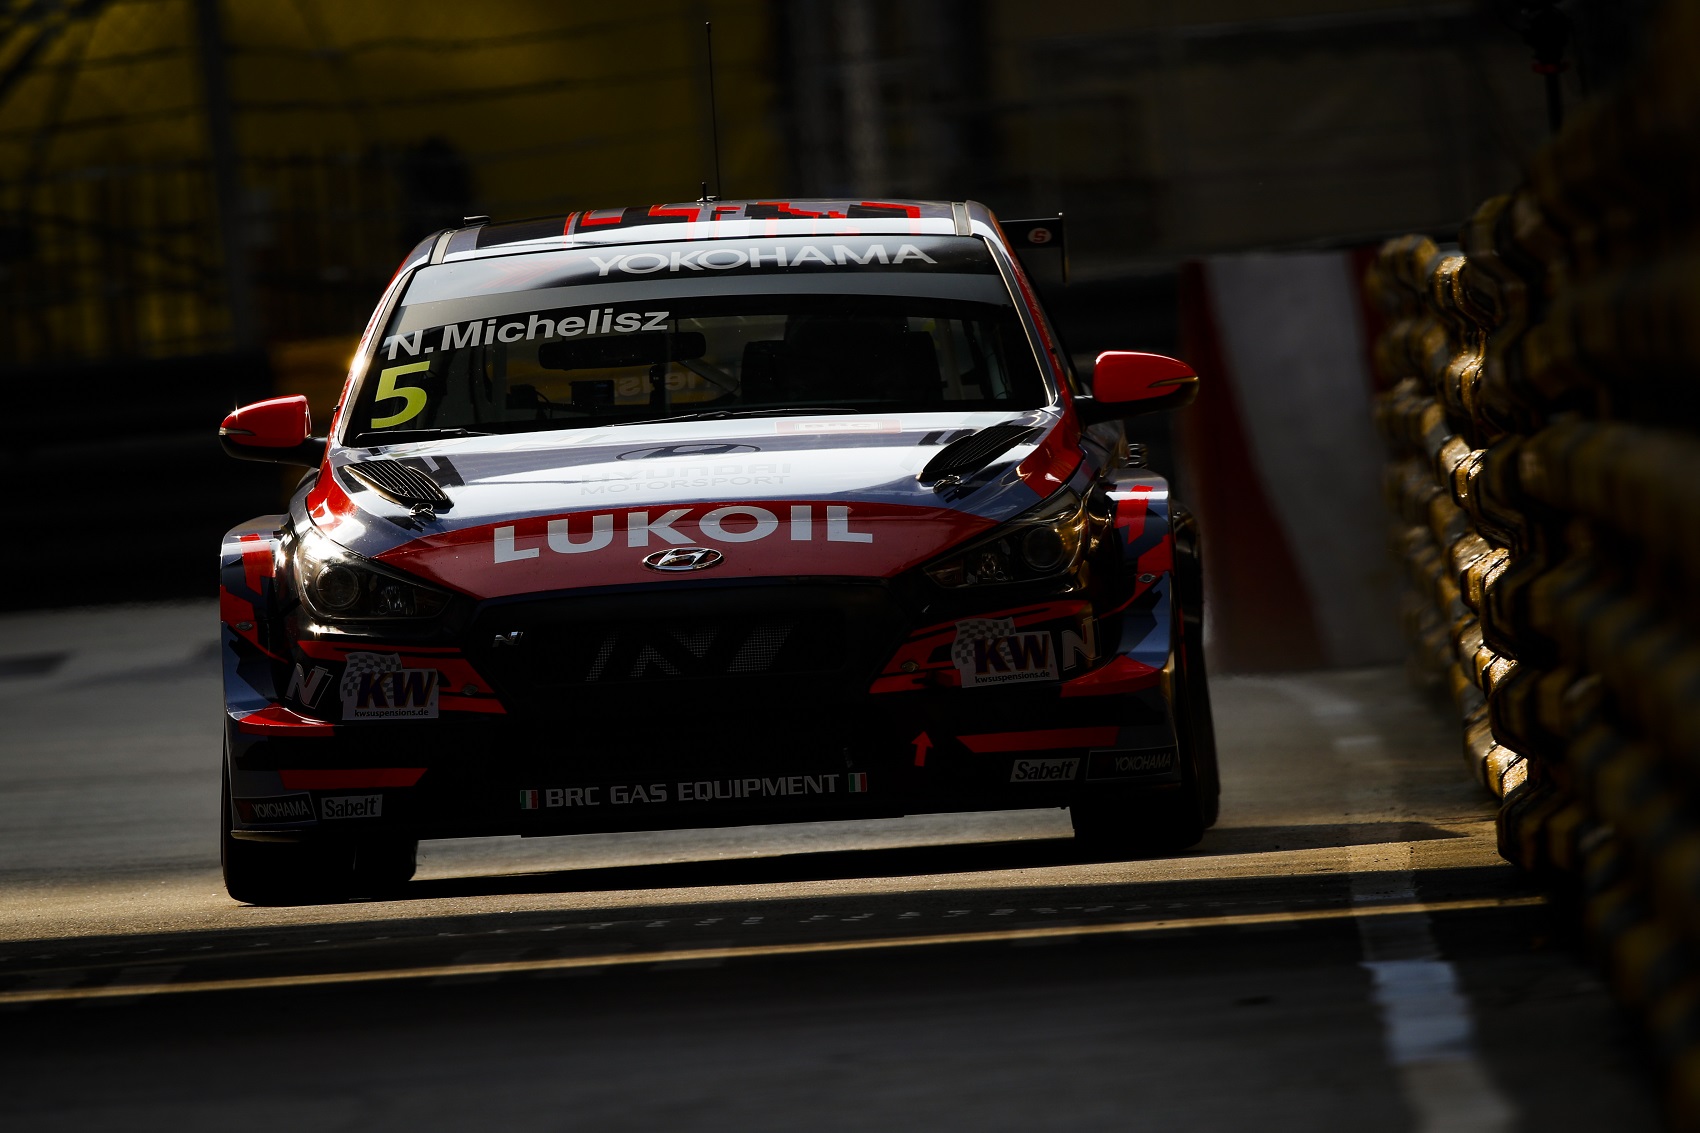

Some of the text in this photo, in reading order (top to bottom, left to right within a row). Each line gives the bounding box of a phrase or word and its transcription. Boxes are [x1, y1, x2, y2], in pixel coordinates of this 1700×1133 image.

[588, 243, 938, 277] YOKOHAMA
[386, 307, 670, 361] N. Michelisz
[370, 360, 431, 429] 5
[580, 475, 790, 496] MOTORSPORT
[581, 463, 792, 484] HYUNDAI
[493, 505, 873, 563] LUKOIL
[974, 634, 1050, 674] KW
[284, 663, 333, 710] N
[356, 671, 436, 708] KW
[974, 670, 1050, 684] kwsuspensions.de
[354, 709, 429, 718] kwsuspensions.de
[1015, 760, 1075, 781] Sabelt
[1115, 752, 1171, 773] YOKOHAMA
[545, 773, 840, 808] BRC GAS EQUIPMENT
[251, 800, 311, 819] YOKOHAMA
[324, 797, 378, 818] Sabelt
